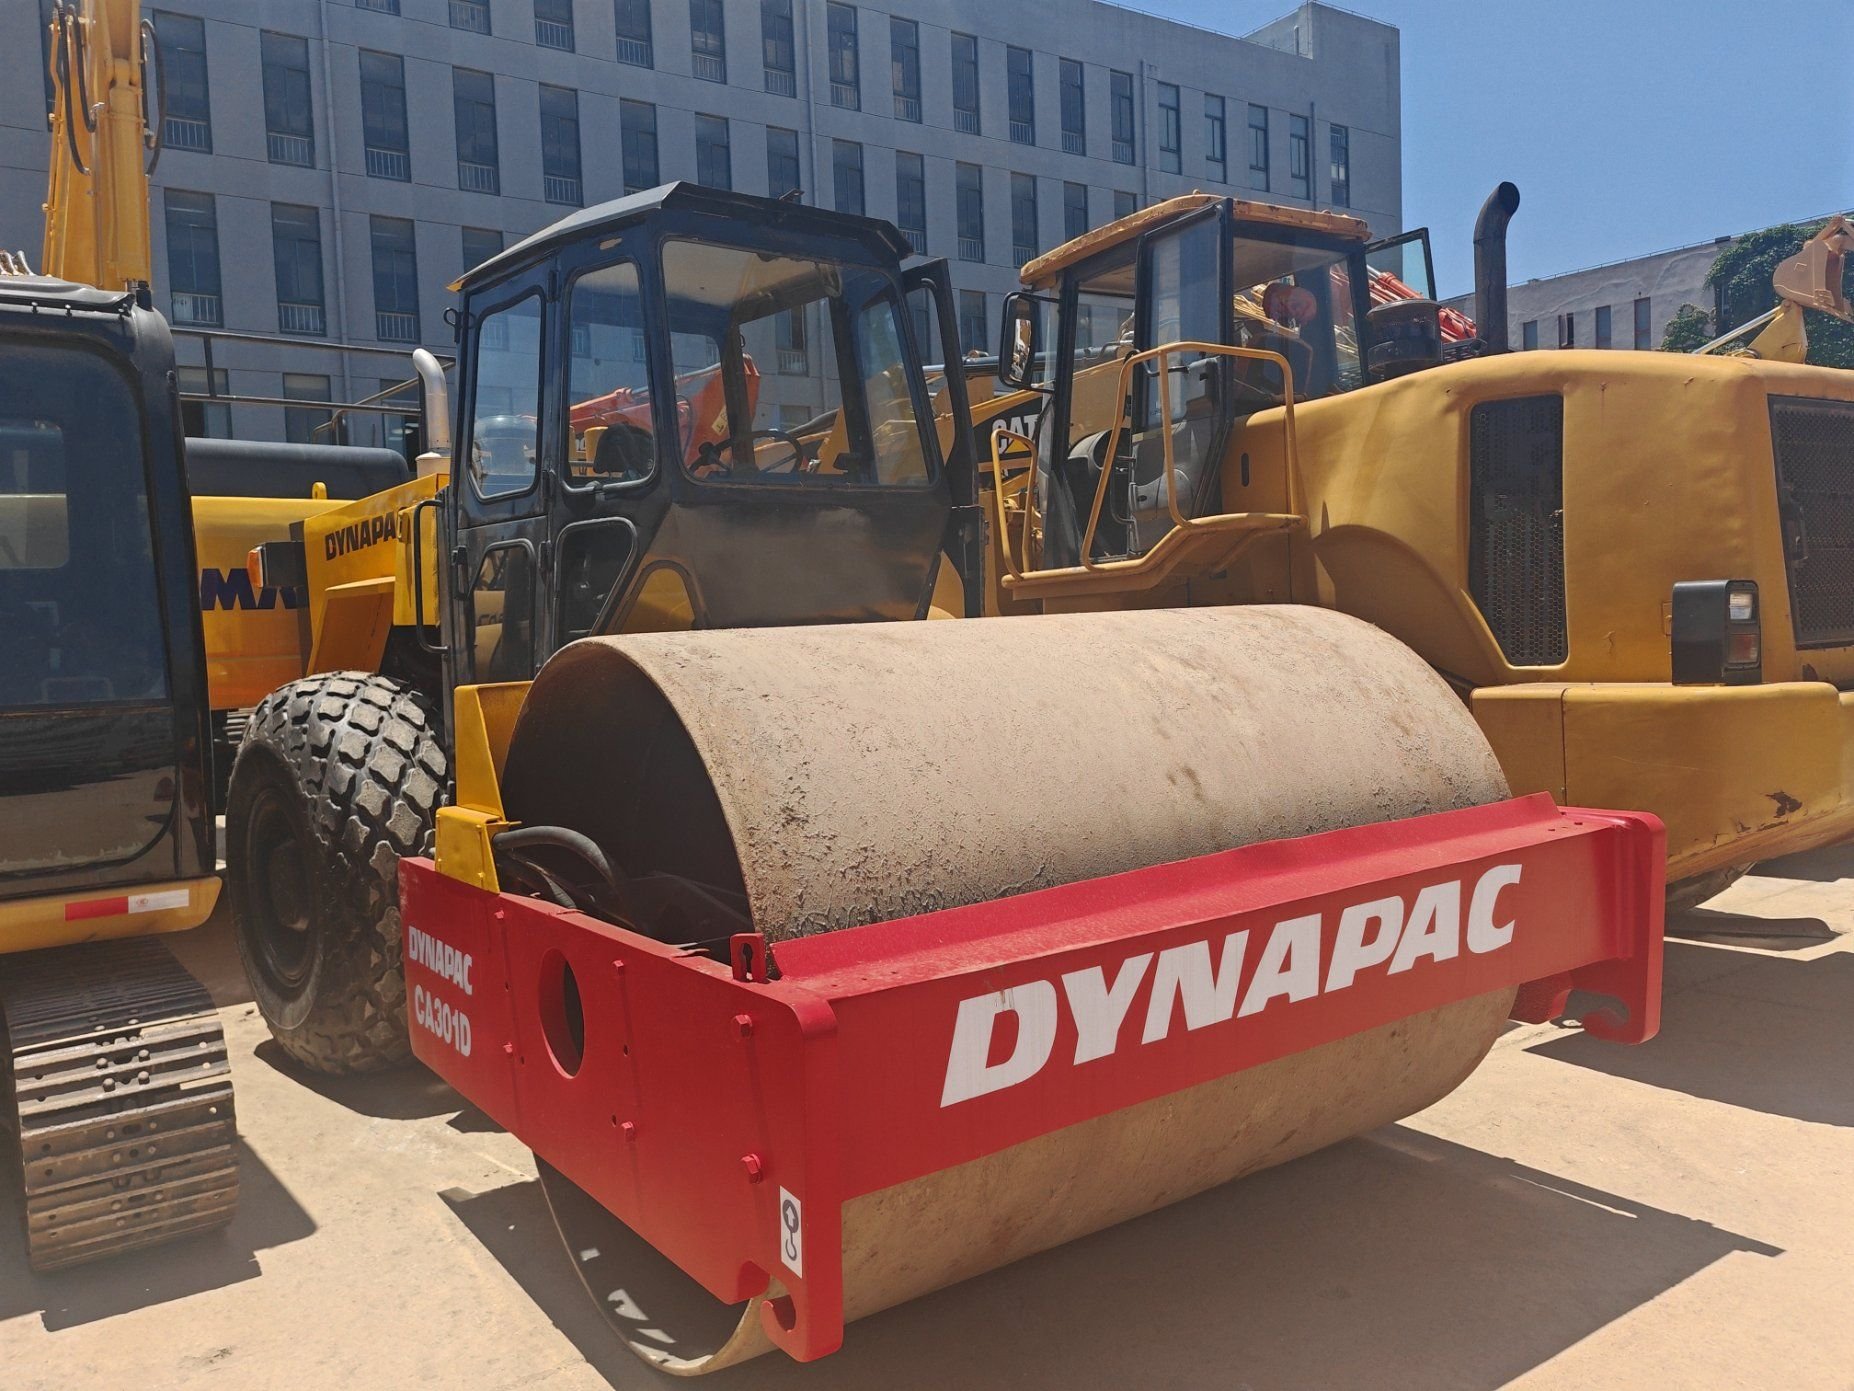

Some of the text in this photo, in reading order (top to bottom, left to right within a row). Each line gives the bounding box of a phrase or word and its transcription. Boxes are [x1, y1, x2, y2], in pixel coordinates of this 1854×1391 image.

[992, 413, 1040, 455] CAT
[325, 507, 408, 561] DYNAPA
[408, 925, 473, 996] DYNAPAC
[940, 864, 1523, 1109] DYNAPAC
[414, 984, 472, 1057] CA301D
